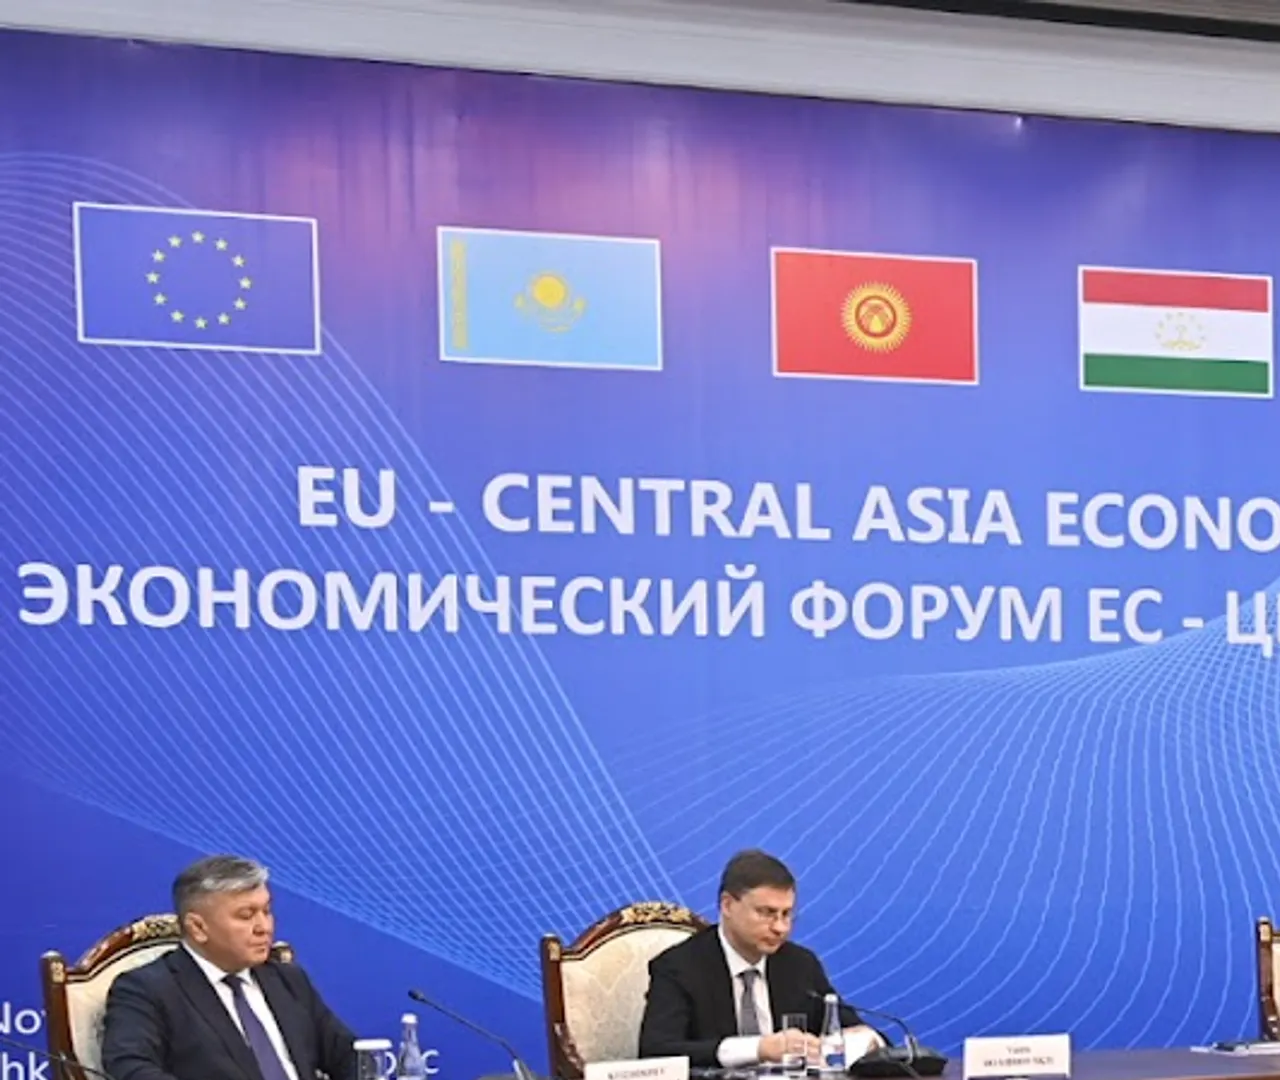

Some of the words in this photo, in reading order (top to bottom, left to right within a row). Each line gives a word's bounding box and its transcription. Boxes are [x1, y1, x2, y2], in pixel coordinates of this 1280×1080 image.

[296, 465, 397, 529] EU
[429, 501, 454, 514] -
[482, 472, 831, 541] CENTRAL
[852, 486, 1022, 545] ASIA
[17, 562, 766, 638] ЭКОНОМИЧЕСКИЙ
[790, 581, 1063, 642] ФОРУМ
[1088, 588, 1163, 644] ЕС
[1183, 617, 1204, 629] -
